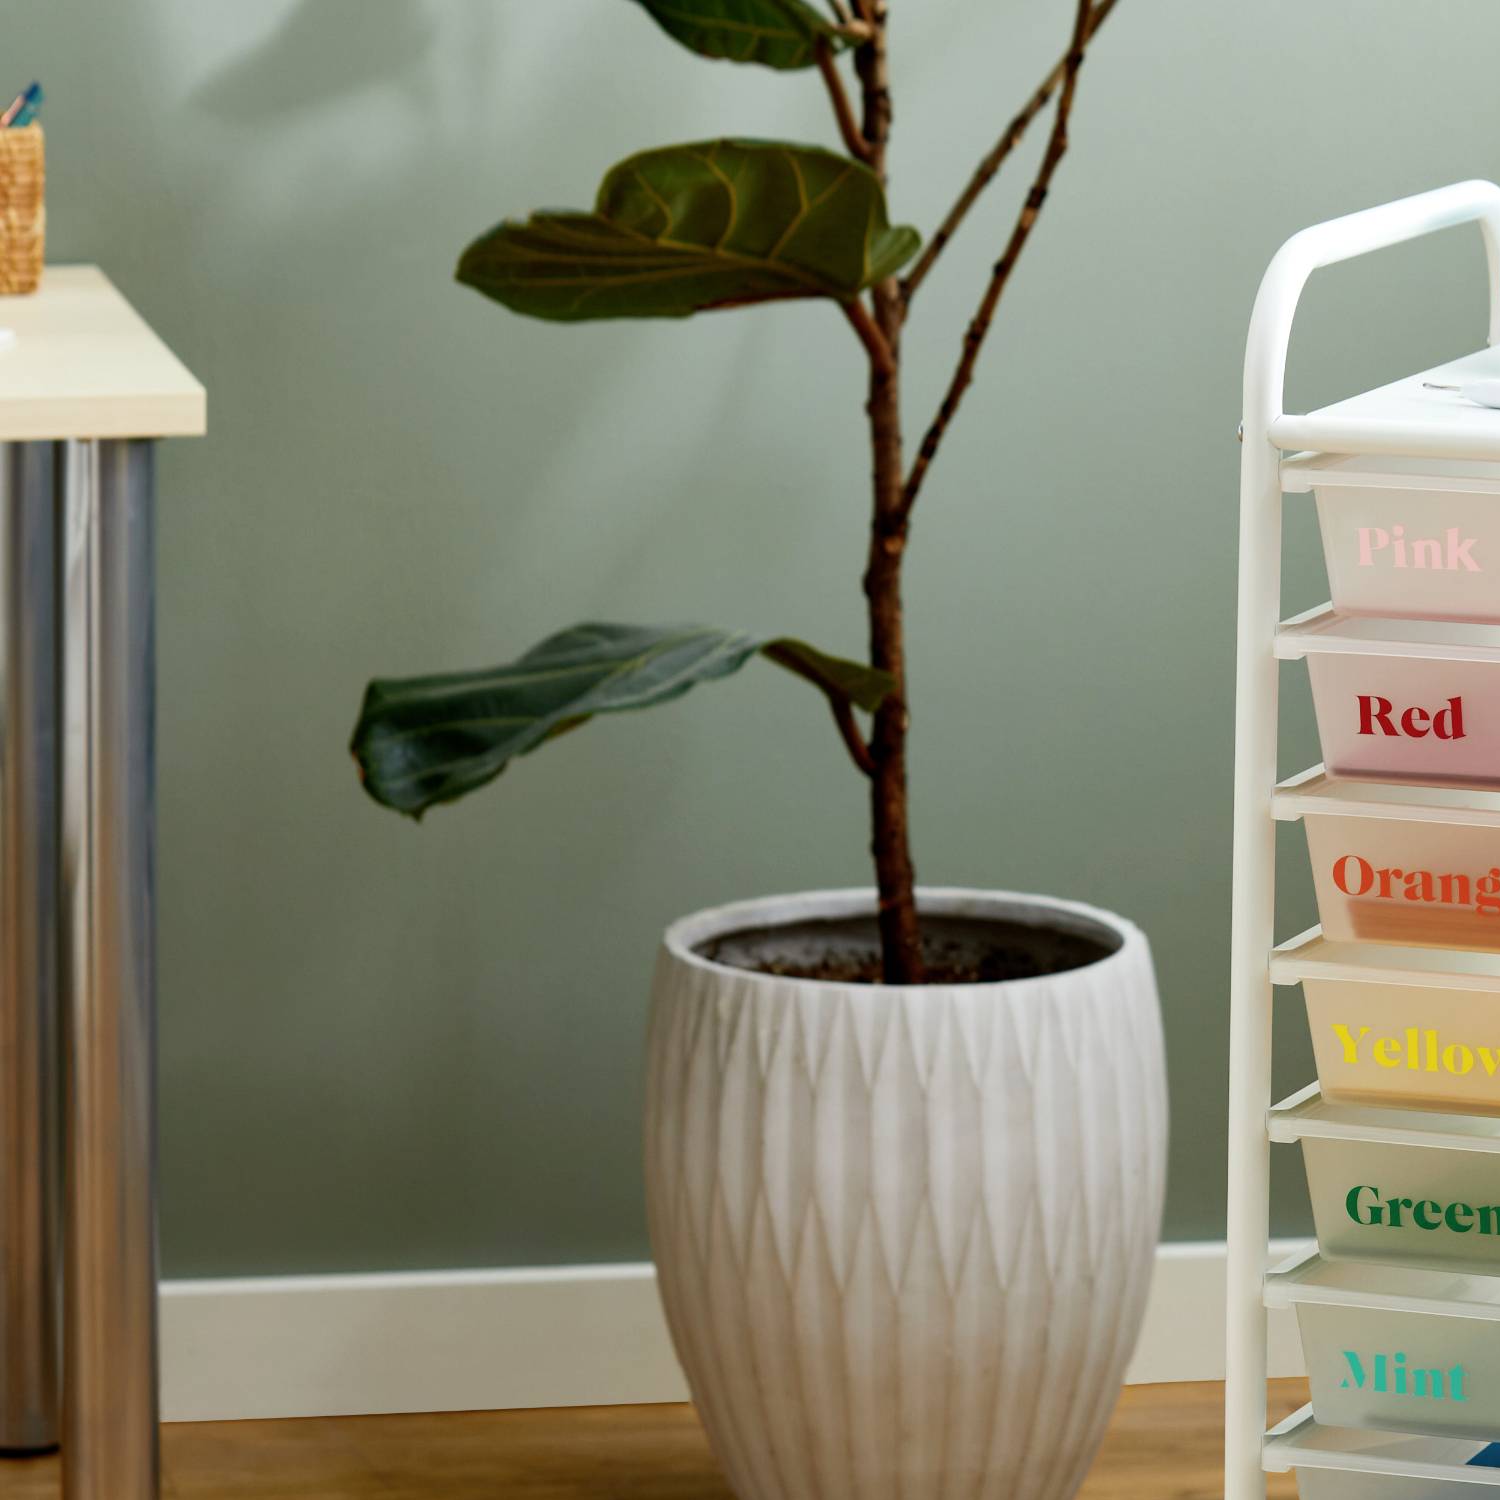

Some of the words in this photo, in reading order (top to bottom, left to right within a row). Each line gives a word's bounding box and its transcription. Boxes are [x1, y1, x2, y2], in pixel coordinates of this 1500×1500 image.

[1357, 526, 1482, 574] Pink
[1356, 695, 1468, 741] Red
[1339, 1351, 1470, 1402] Mint
